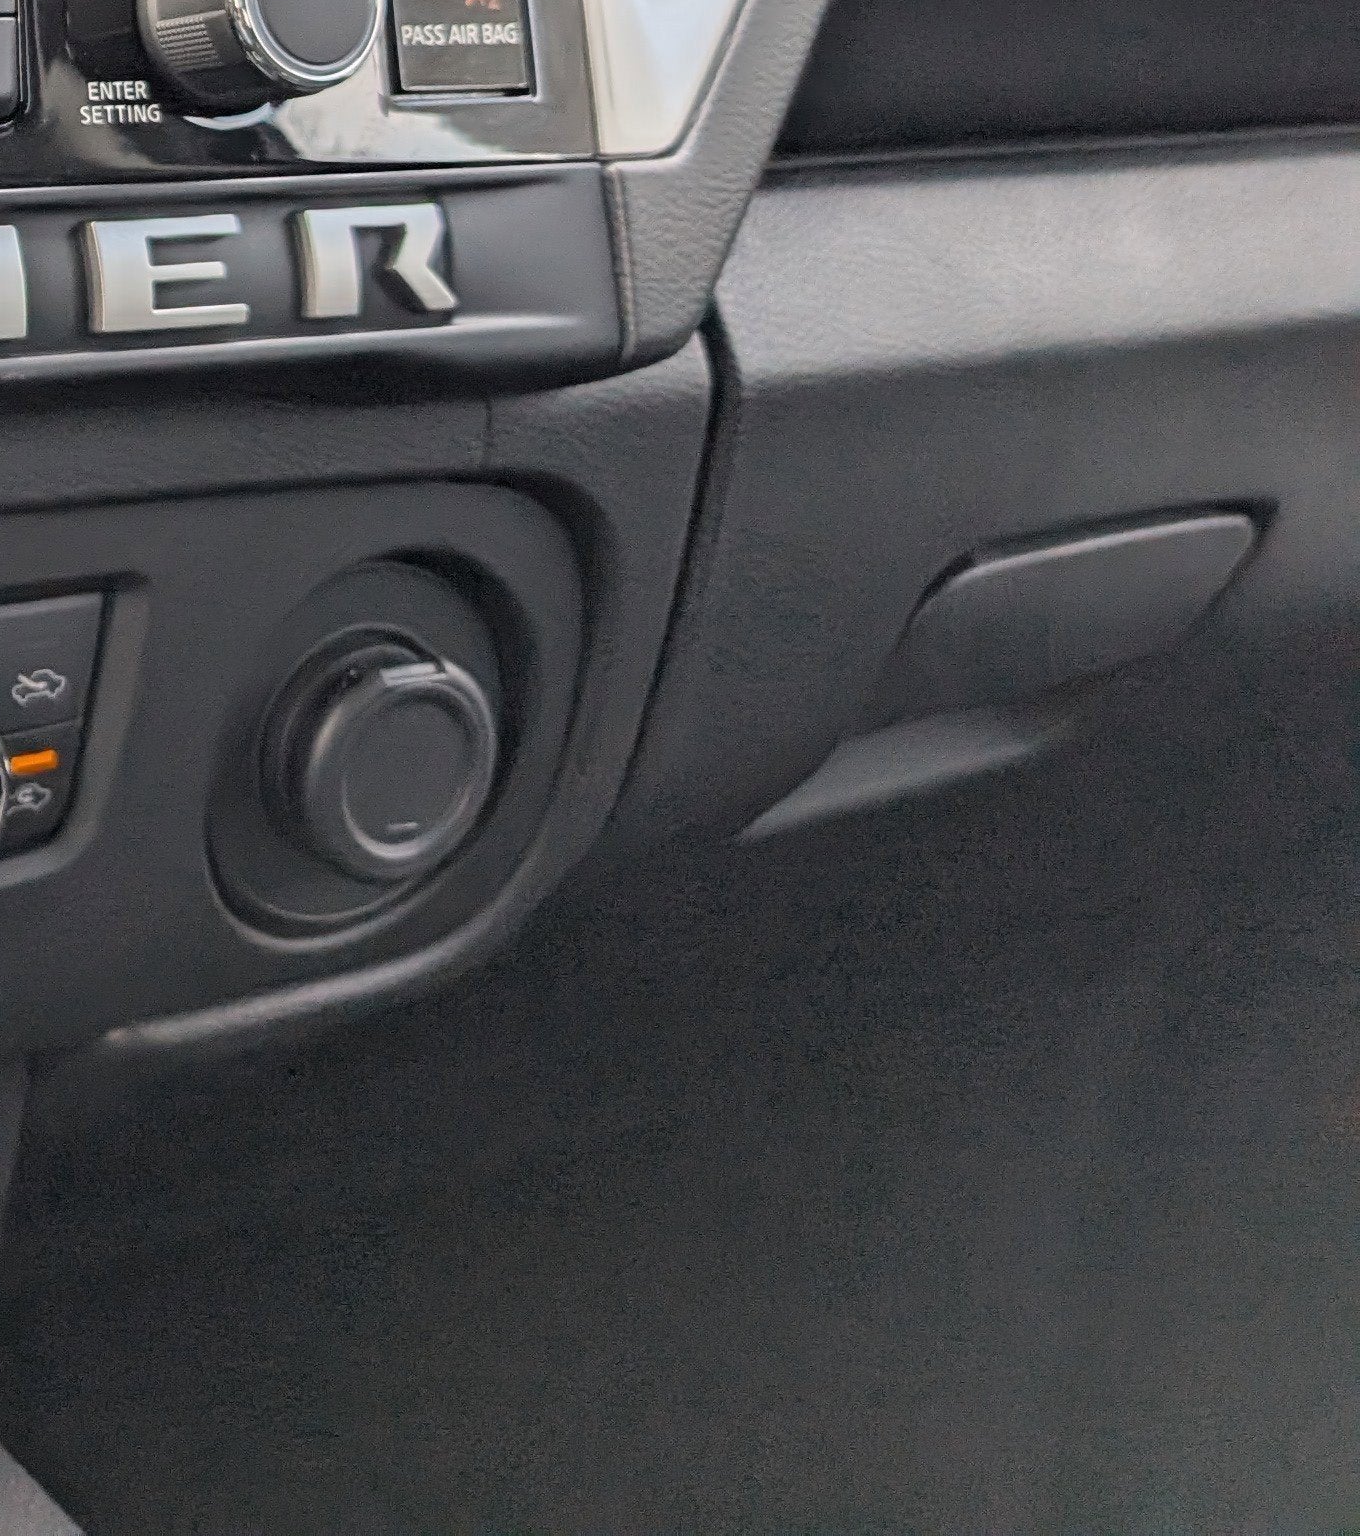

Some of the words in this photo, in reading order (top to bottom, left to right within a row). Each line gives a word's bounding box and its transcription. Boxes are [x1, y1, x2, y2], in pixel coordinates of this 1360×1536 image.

[401, 23, 445, 46] PASS
[449, 23, 478, 45] AIR
[482, 22, 518, 44] BAG
[88, 81, 146, 101] ENTER
[81, 104, 161, 125] SETTING
